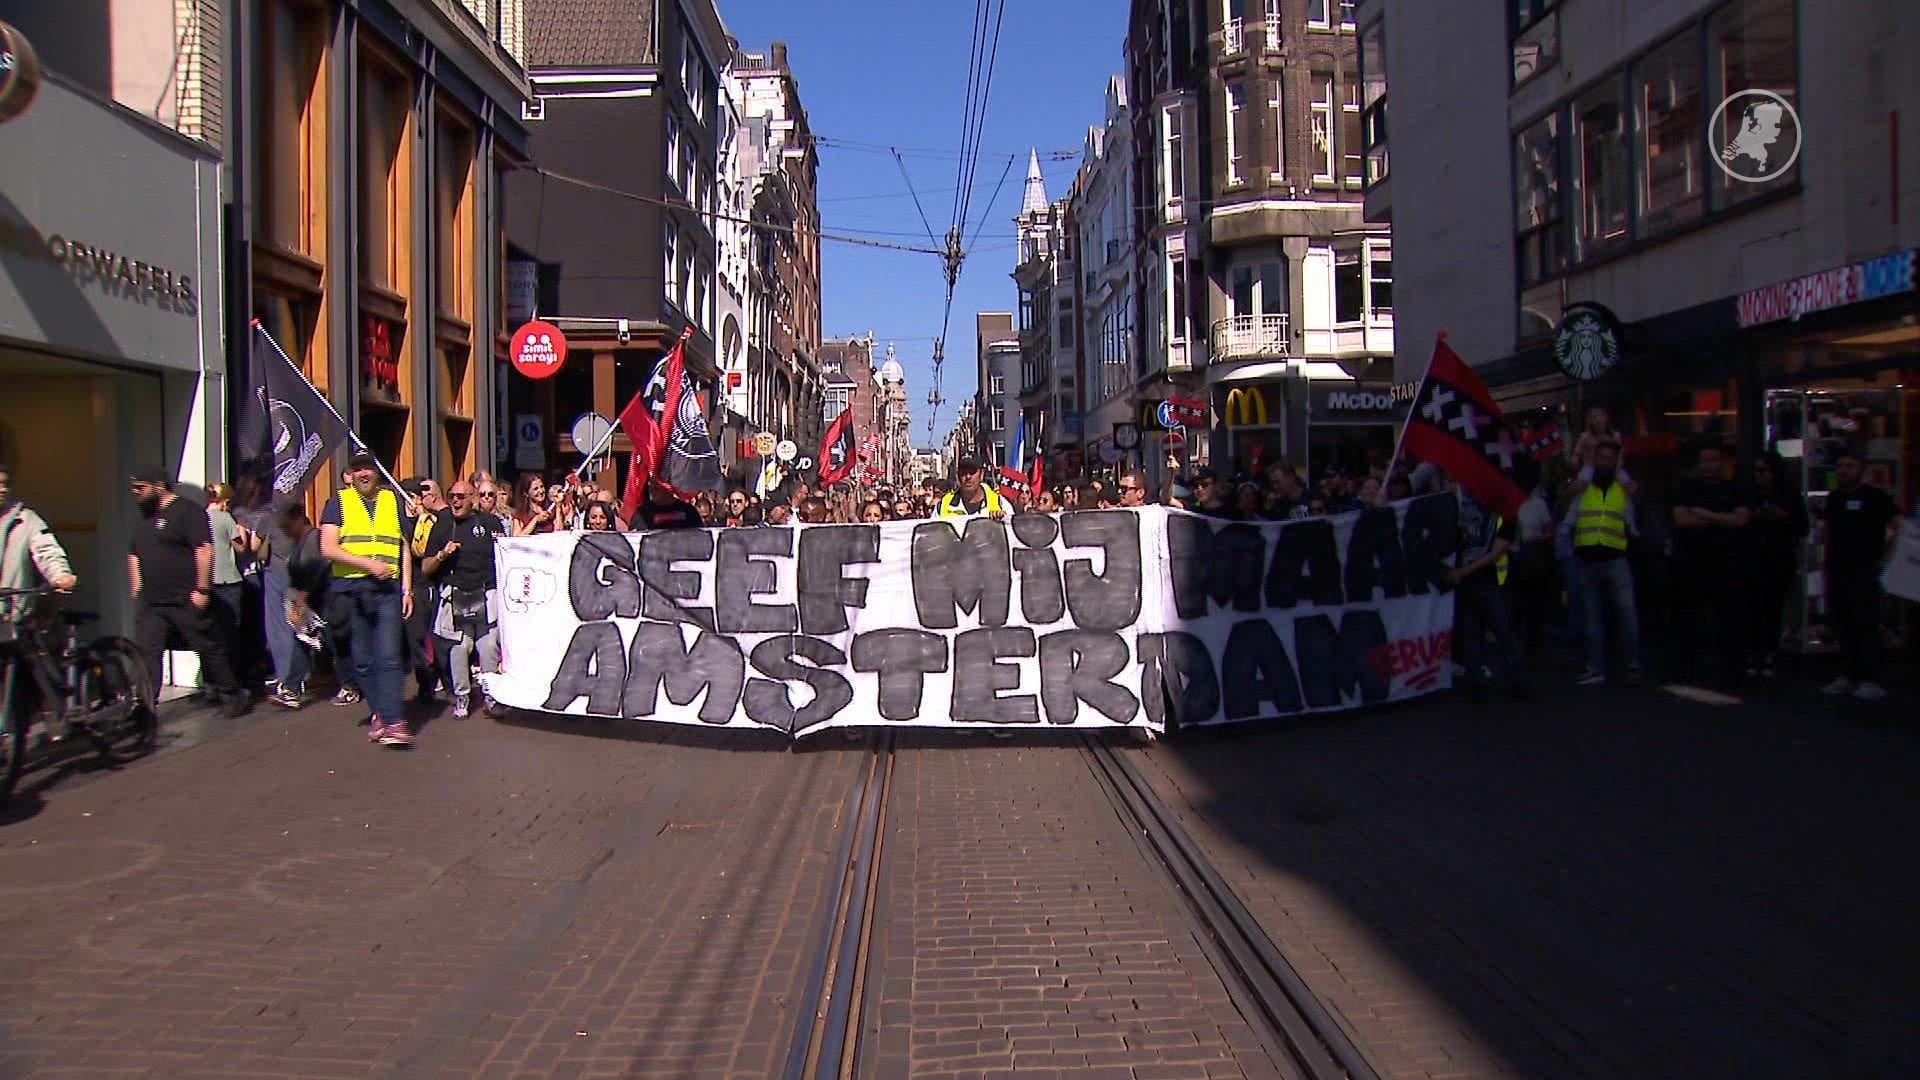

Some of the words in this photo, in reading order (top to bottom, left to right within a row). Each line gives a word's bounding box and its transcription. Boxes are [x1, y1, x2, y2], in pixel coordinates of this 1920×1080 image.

[523, 341, 553, 353] simit
[796, 457, 812, 470] JD
[569, 527, 881, 635] GEEF
[1166, 492, 1457, 619] MAAR
[542, 610, 1390, 732] AMSTERDAM
